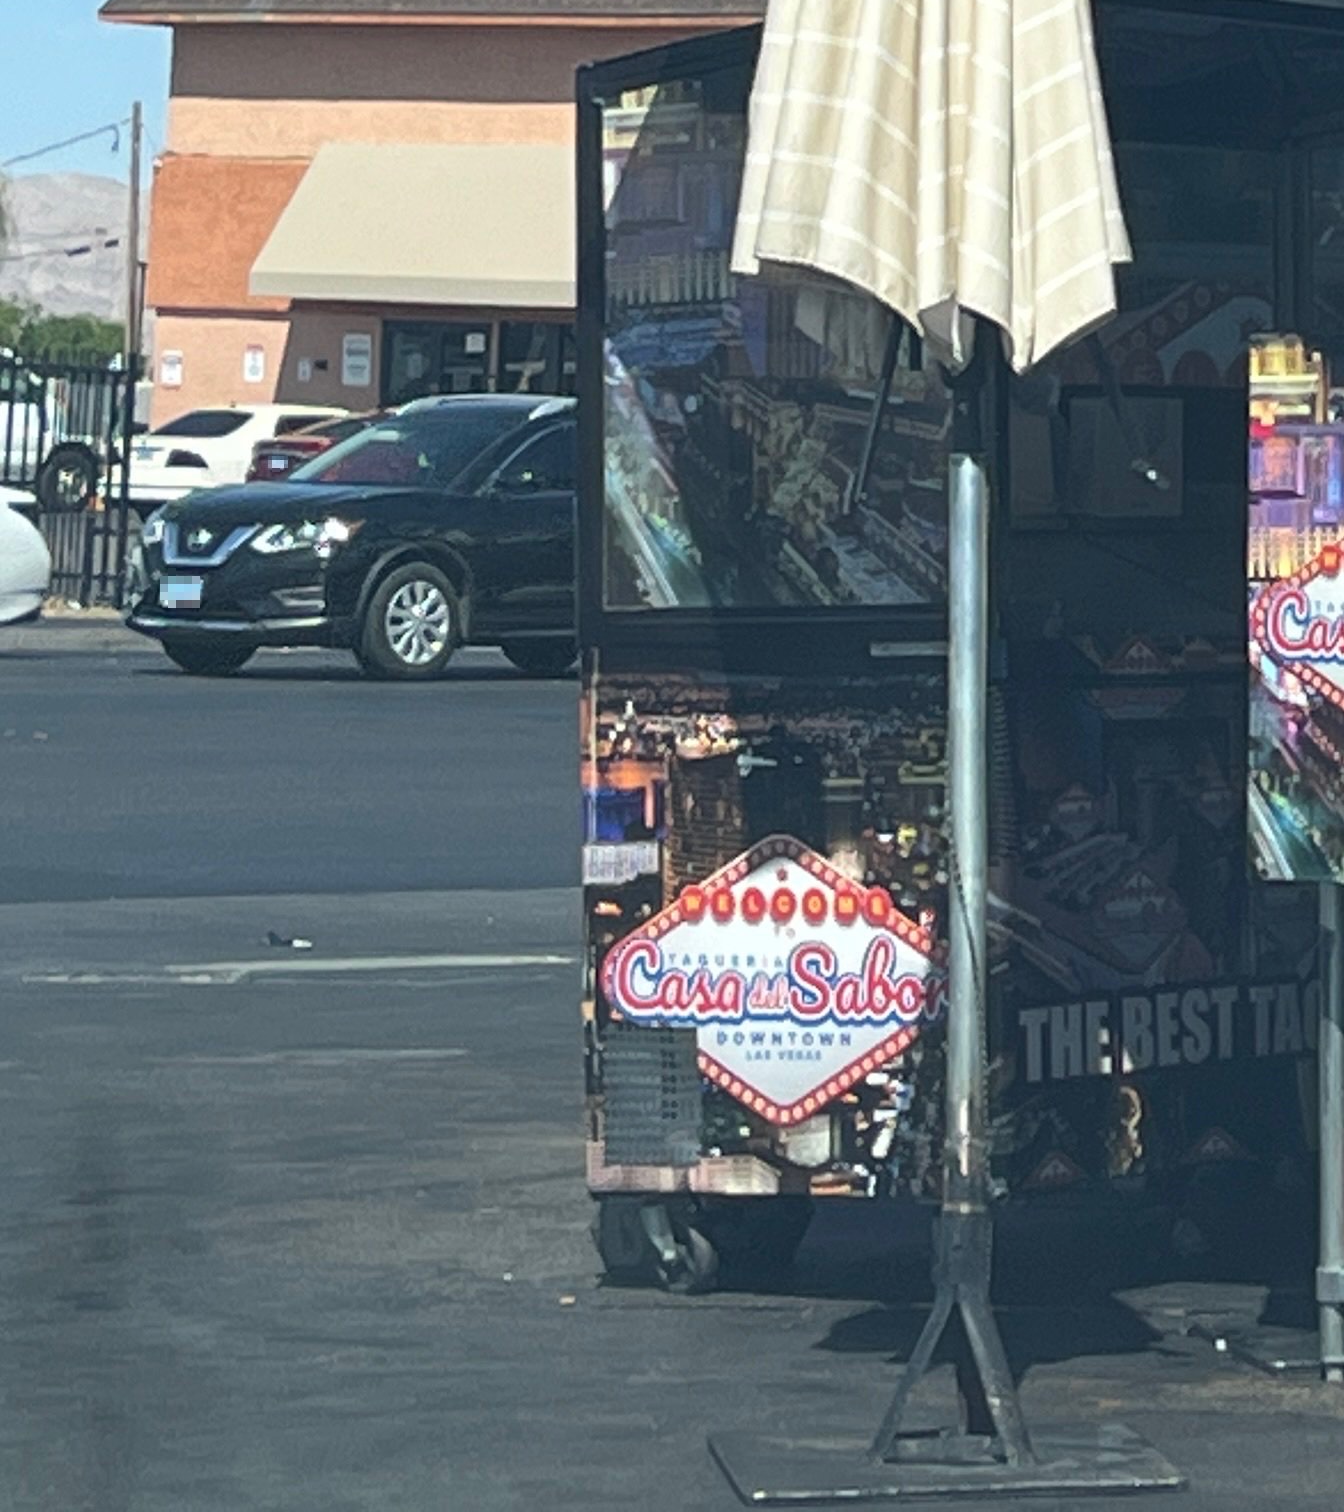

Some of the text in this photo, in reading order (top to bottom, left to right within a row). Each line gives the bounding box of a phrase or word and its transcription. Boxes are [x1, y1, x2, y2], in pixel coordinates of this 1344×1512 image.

[683, 892, 888, 919] WELCOME
[617, 939, 742, 1012] Casa
[790, 936, 948, 1021] Sabor
[716, 1031, 853, 1047] DOWNTOWN
[1020, 1003, 1113, 1084] THE
[1121, 986, 1241, 1073] BEST
